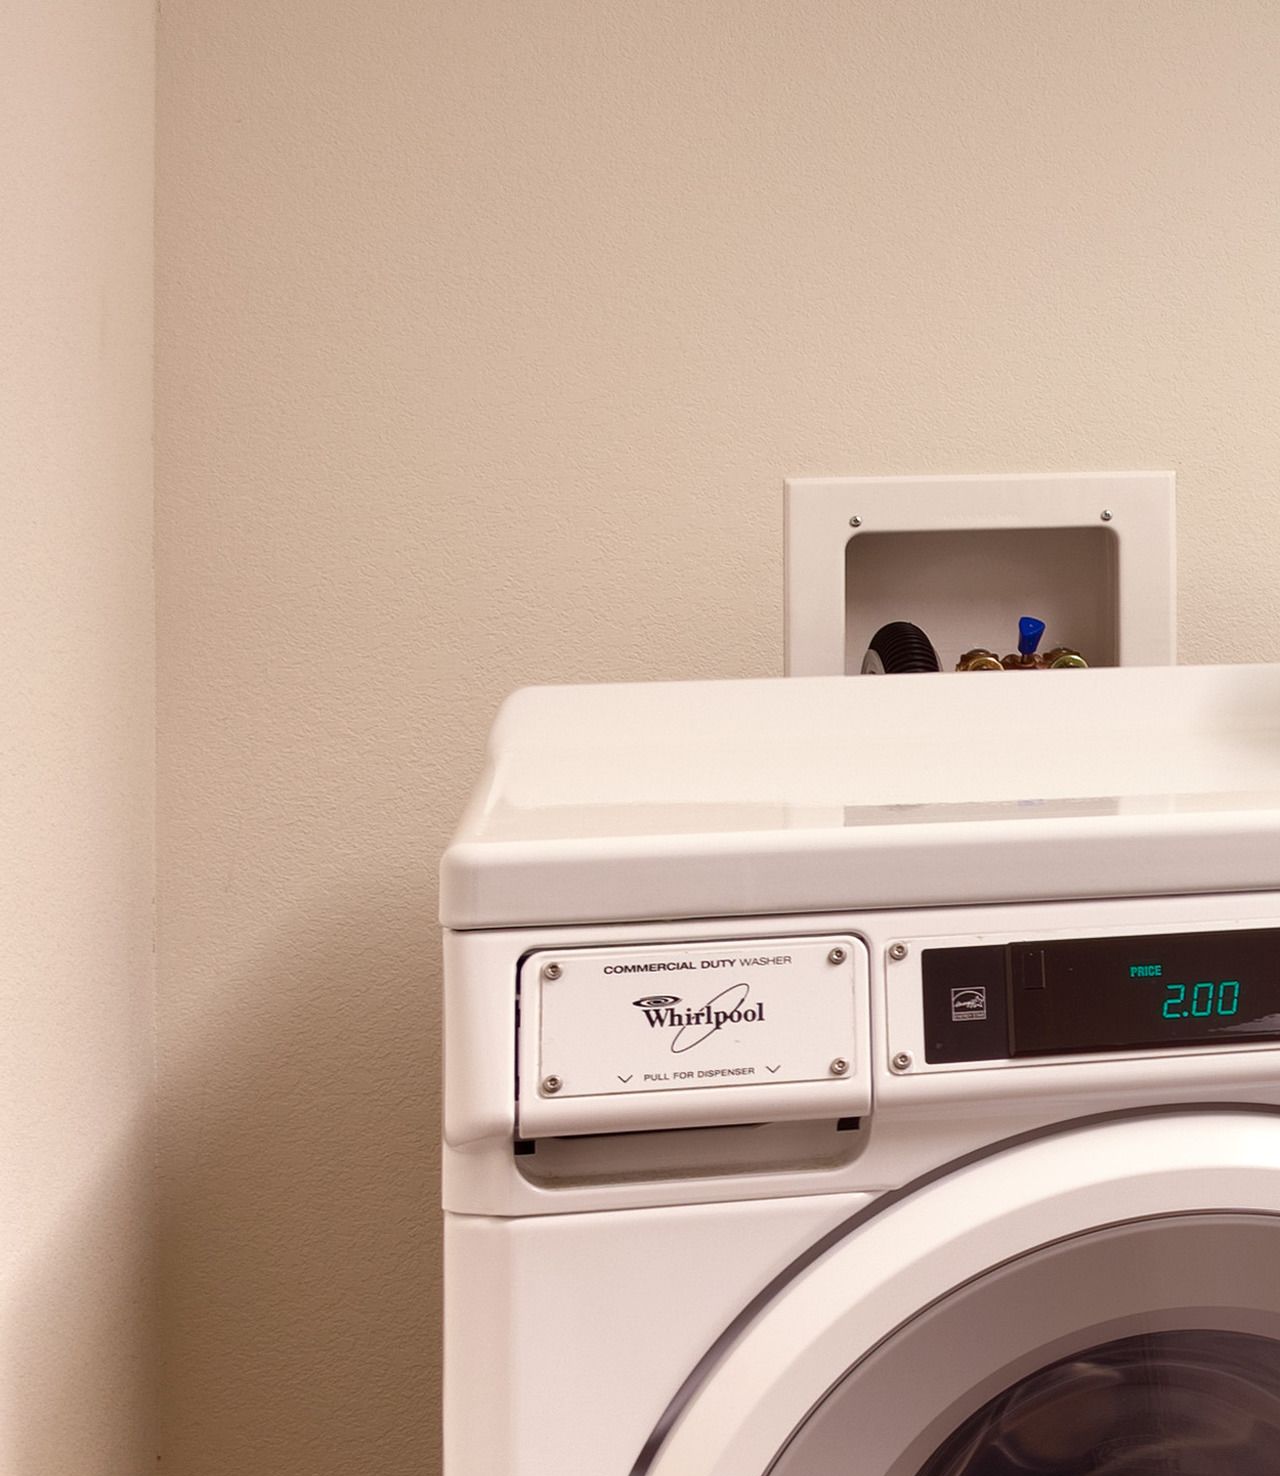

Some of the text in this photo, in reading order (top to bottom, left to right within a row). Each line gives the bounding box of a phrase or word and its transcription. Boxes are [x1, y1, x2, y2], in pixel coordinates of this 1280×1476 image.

[603, 955, 792, 975] COMMERCIAL DUTY WASHER
[1129, 964, 1162, 978] PRICE
[1163, 981, 1240, 1018] 2.00
[641, 1002, 765, 1030] Whirlpool
[643, 1067, 755, 1082] PULL FOR DISPENSER
